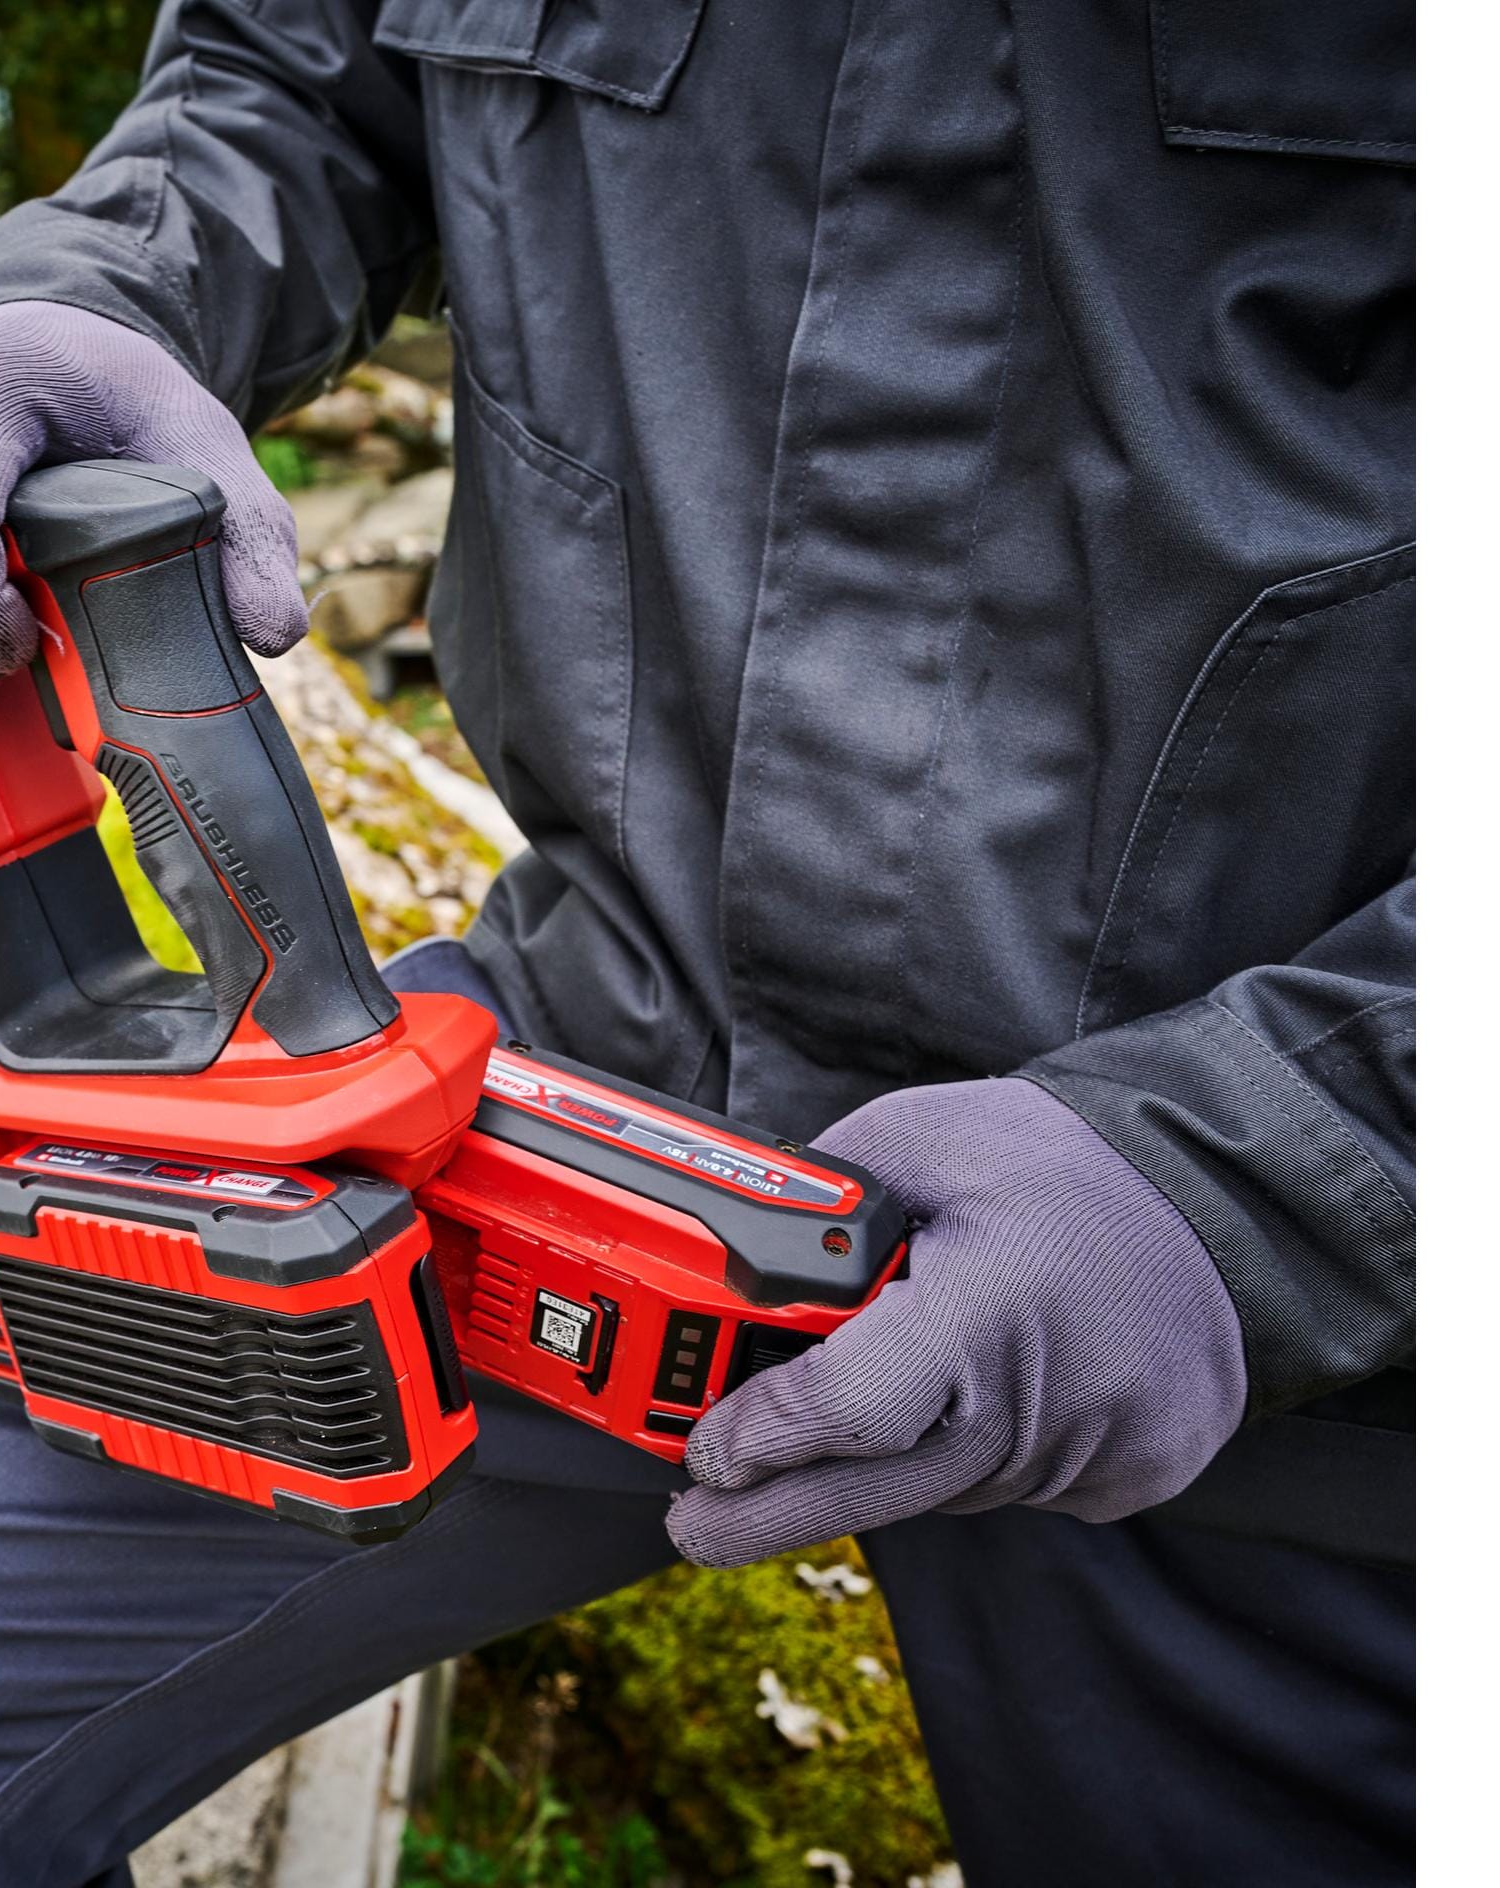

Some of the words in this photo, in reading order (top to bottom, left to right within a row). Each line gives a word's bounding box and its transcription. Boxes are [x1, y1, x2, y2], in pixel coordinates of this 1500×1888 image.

[159, 752, 298, 955] BRUSHLESS
[558, 1099, 619, 1128] POWER
[153, 1165, 201, 1179] POWER
